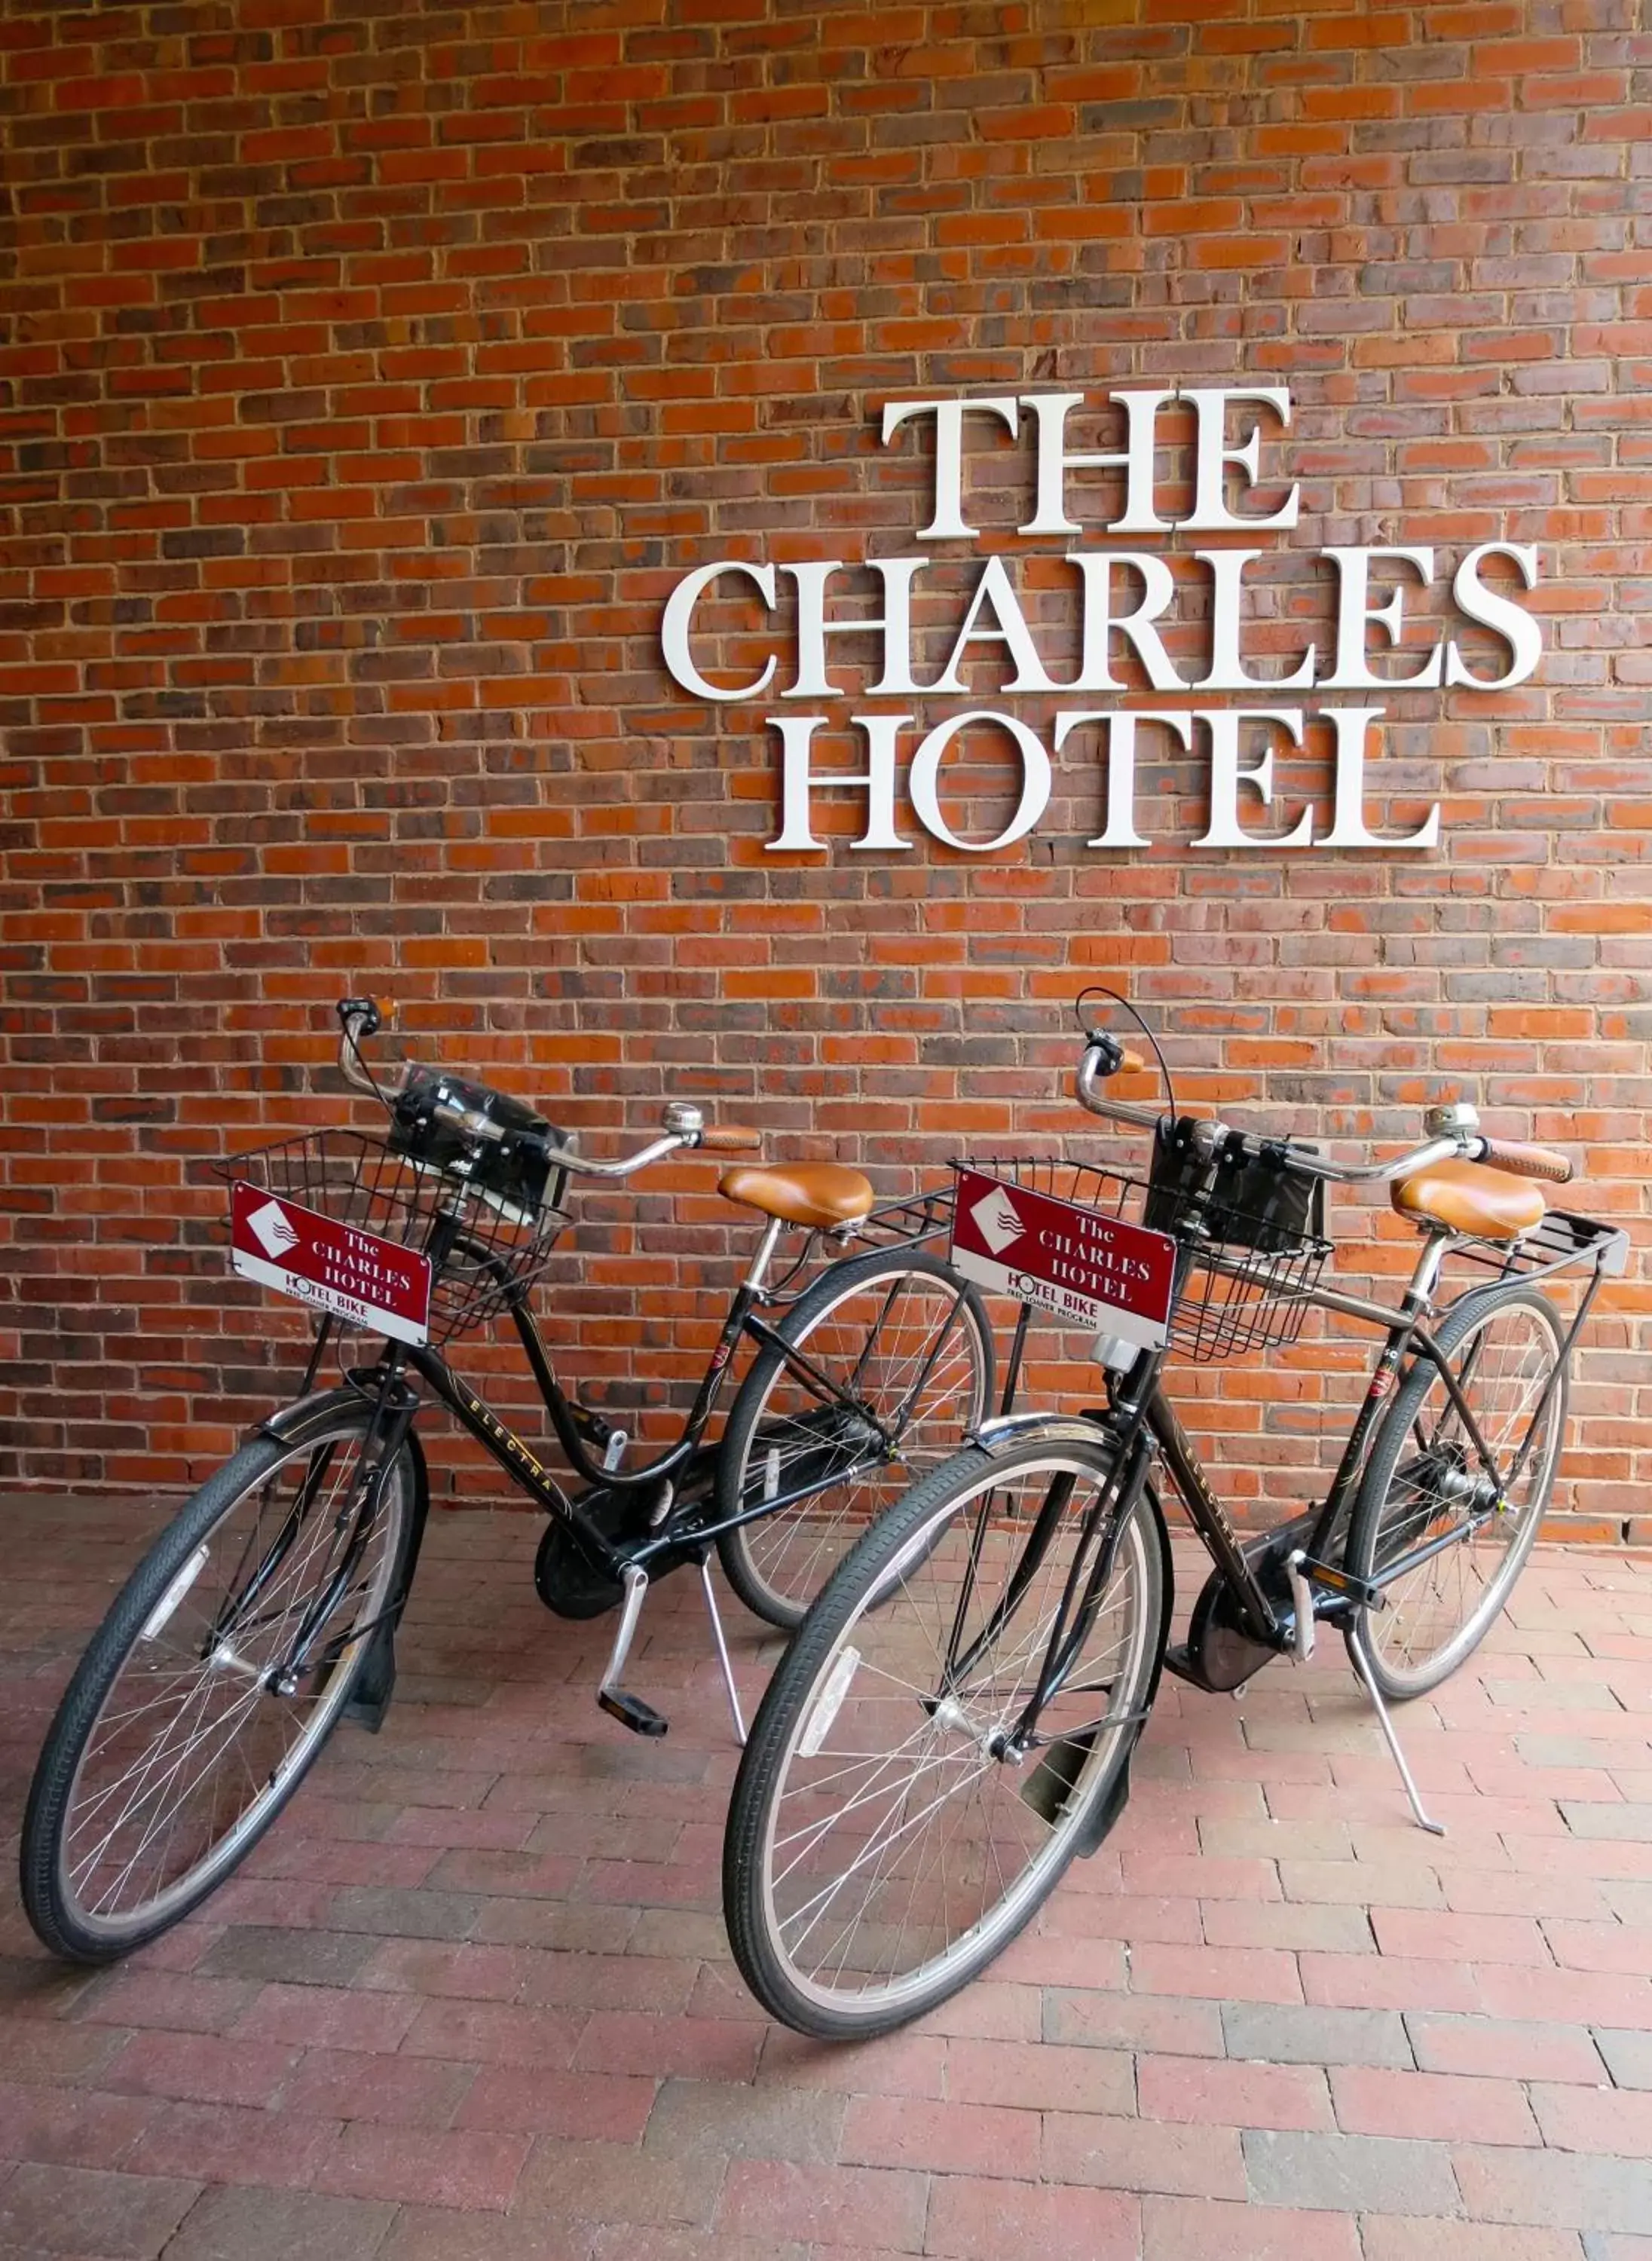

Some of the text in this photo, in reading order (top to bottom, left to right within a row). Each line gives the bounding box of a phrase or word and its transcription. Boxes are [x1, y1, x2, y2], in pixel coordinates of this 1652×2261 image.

[881, 385, 1301, 541] THE
[660, 540, 1544, 703] CHARLES
[763, 707, 1441, 852] HOTEL
[344, 1230, 379, 1256] The
[1075, 1215, 1115, 1244] The
[311, 1241, 411, 1292] CHARLES
[1039, 1229, 1151, 1281] CHARLES
[286, 1274, 369, 1317] HOTEL BIKE
[324, 1265, 398, 1307] HOTEL
[1008, 1271, 1098, 1318] HOTEL BIKE
[1051, 1259, 1133, 1302] HOTEL
[1057, 1308, 1097, 1329] PROGRAM
[470, 1400, 552, 1491] ELECTRA
